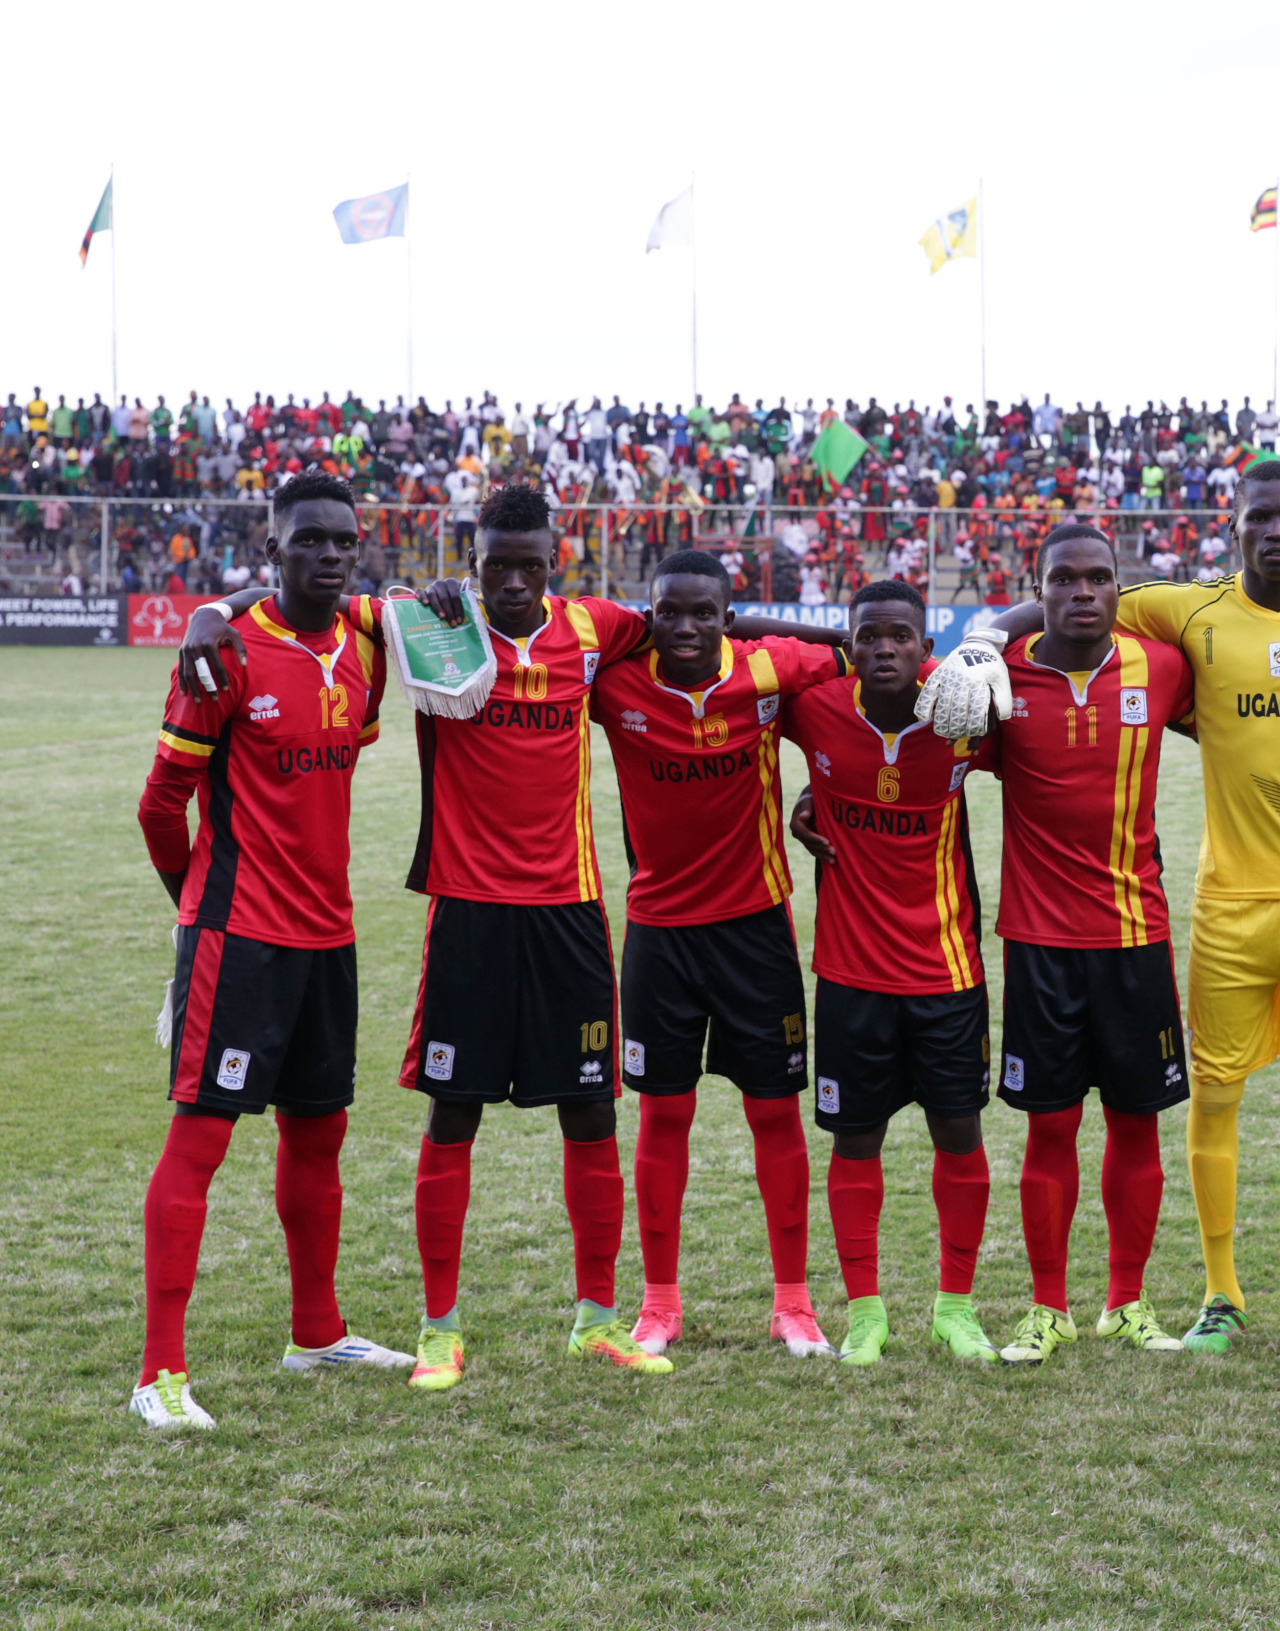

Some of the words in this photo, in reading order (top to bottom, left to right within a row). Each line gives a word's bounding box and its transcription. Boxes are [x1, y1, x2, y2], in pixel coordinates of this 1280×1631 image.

[5, 612, 119, 627] PERFORMANCE
[88, 598, 119, 612] LIFE
[1203, 627, 1213, 665] 1
[512, 662, 548, 700] 10
[318, 683, 349, 729] 12
[691, 712, 729, 750] 15
[1064, 706, 1097, 746] 11
[277, 744, 354, 774] UGAND
[650, 749, 752, 783] UGANDA
[877, 766, 900, 803] 6
[831, 800, 927, 836] UGANDA
[580, 1020, 608, 1053] 10
[782, 1012, 804, 1046] 15
